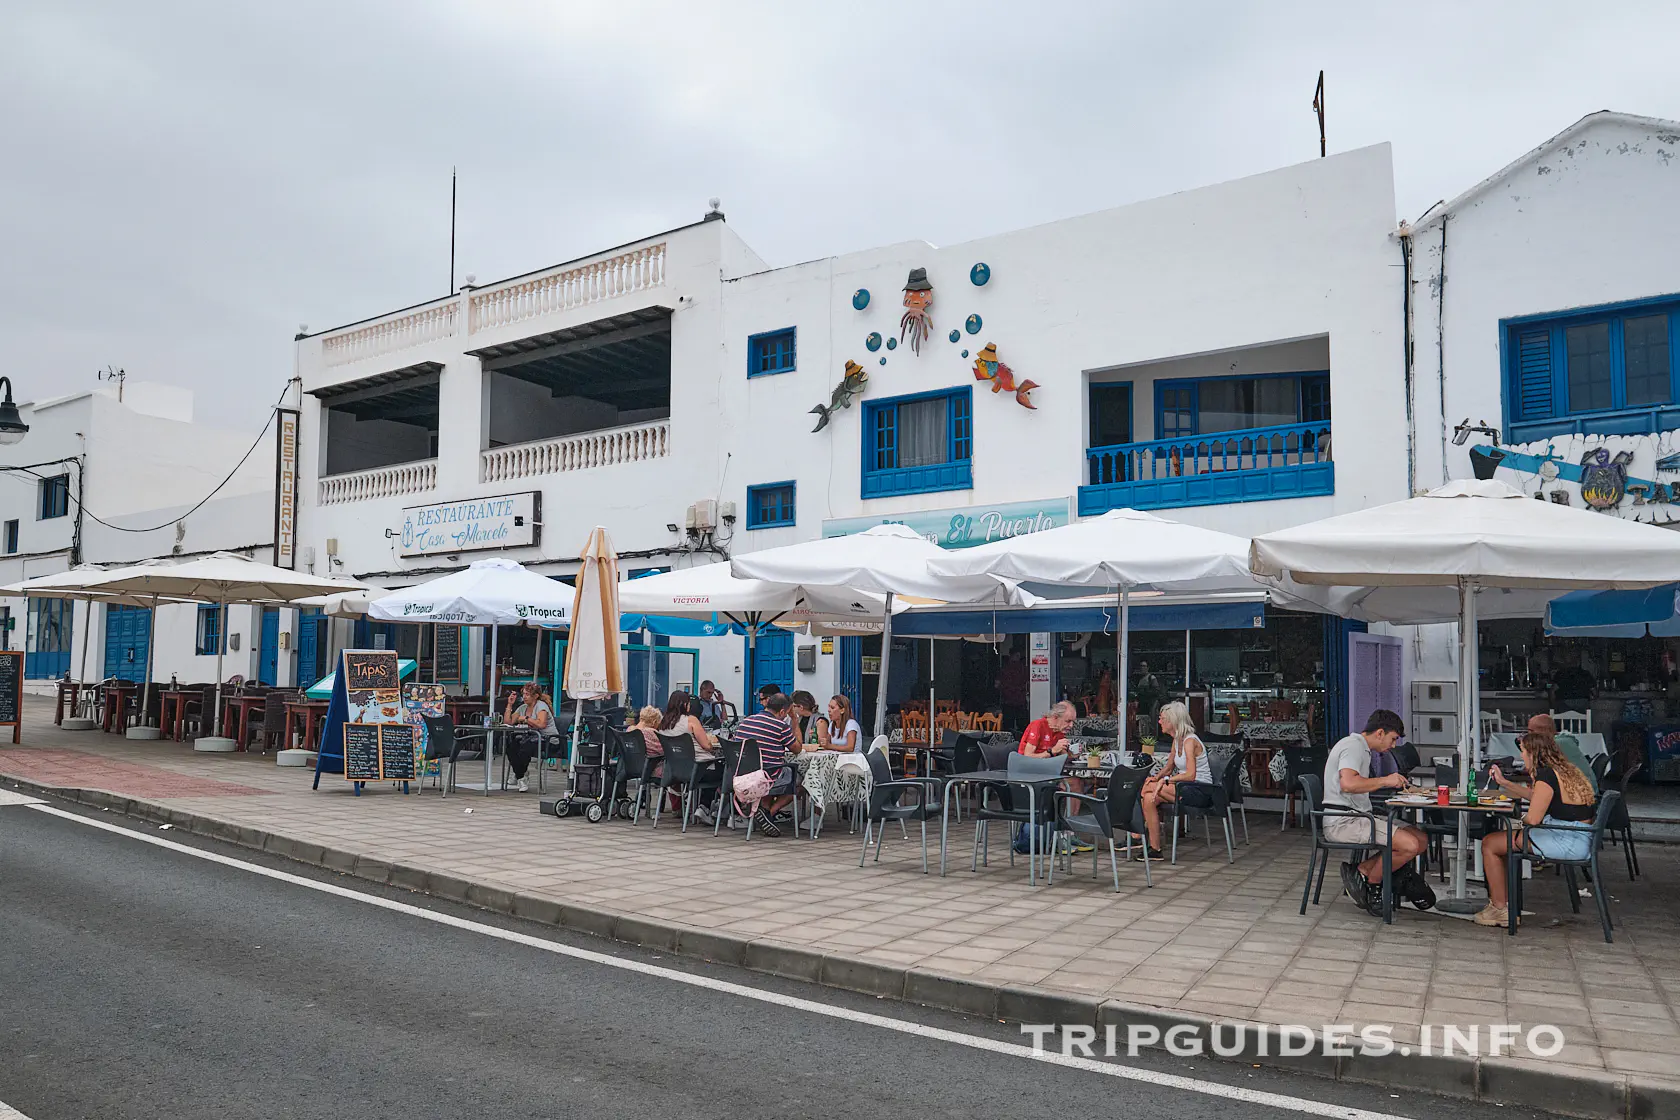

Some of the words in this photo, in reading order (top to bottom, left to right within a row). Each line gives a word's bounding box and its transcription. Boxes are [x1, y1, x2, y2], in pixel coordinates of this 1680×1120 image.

[280, 421, 294, 556] RESTAURANTE
[417, 500, 514, 527] RESTAURANTE
[946, 513, 973, 544] El
[979, 510, 1055, 542] Puerto
[416, 527, 446, 550] Casa
[451, 521, 509, 548] Marcelo
[411, 603, 435, 614] Tropical
[529, 606, 565, 619] Tropical
